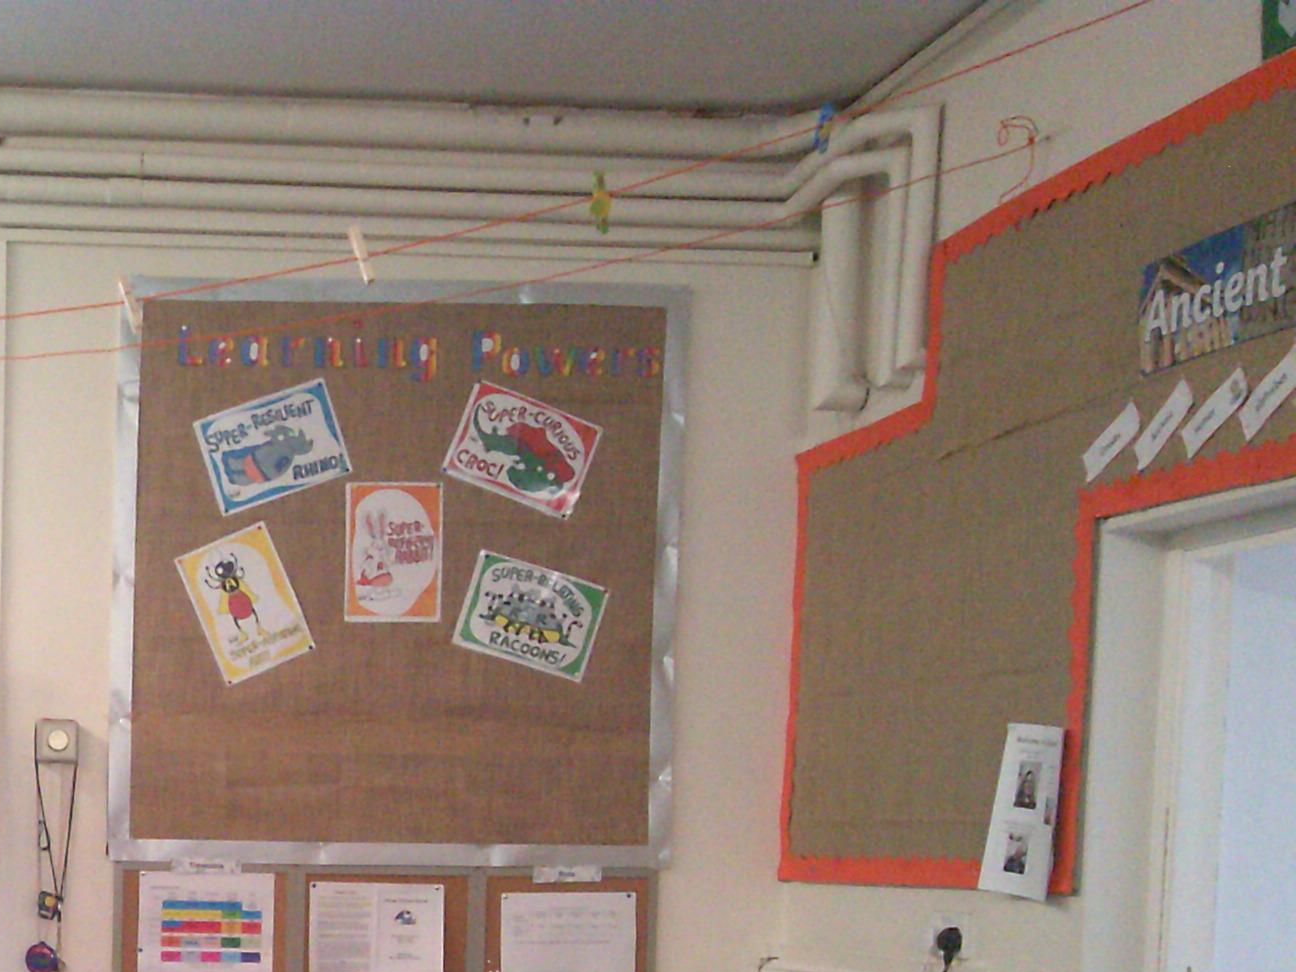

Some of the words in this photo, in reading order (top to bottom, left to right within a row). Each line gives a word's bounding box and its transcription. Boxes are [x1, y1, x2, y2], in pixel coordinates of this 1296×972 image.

[1144, 247, 1287, 343] Ancient
[178, 319, 438, 382] Learning
[471, 331, 661, 378] Powers
[481, 400, 582, 461] SUPER-CURIOUS
[456, 449, 505, 480] CROC!
[488, 631, 566, 666] RACOONS!
